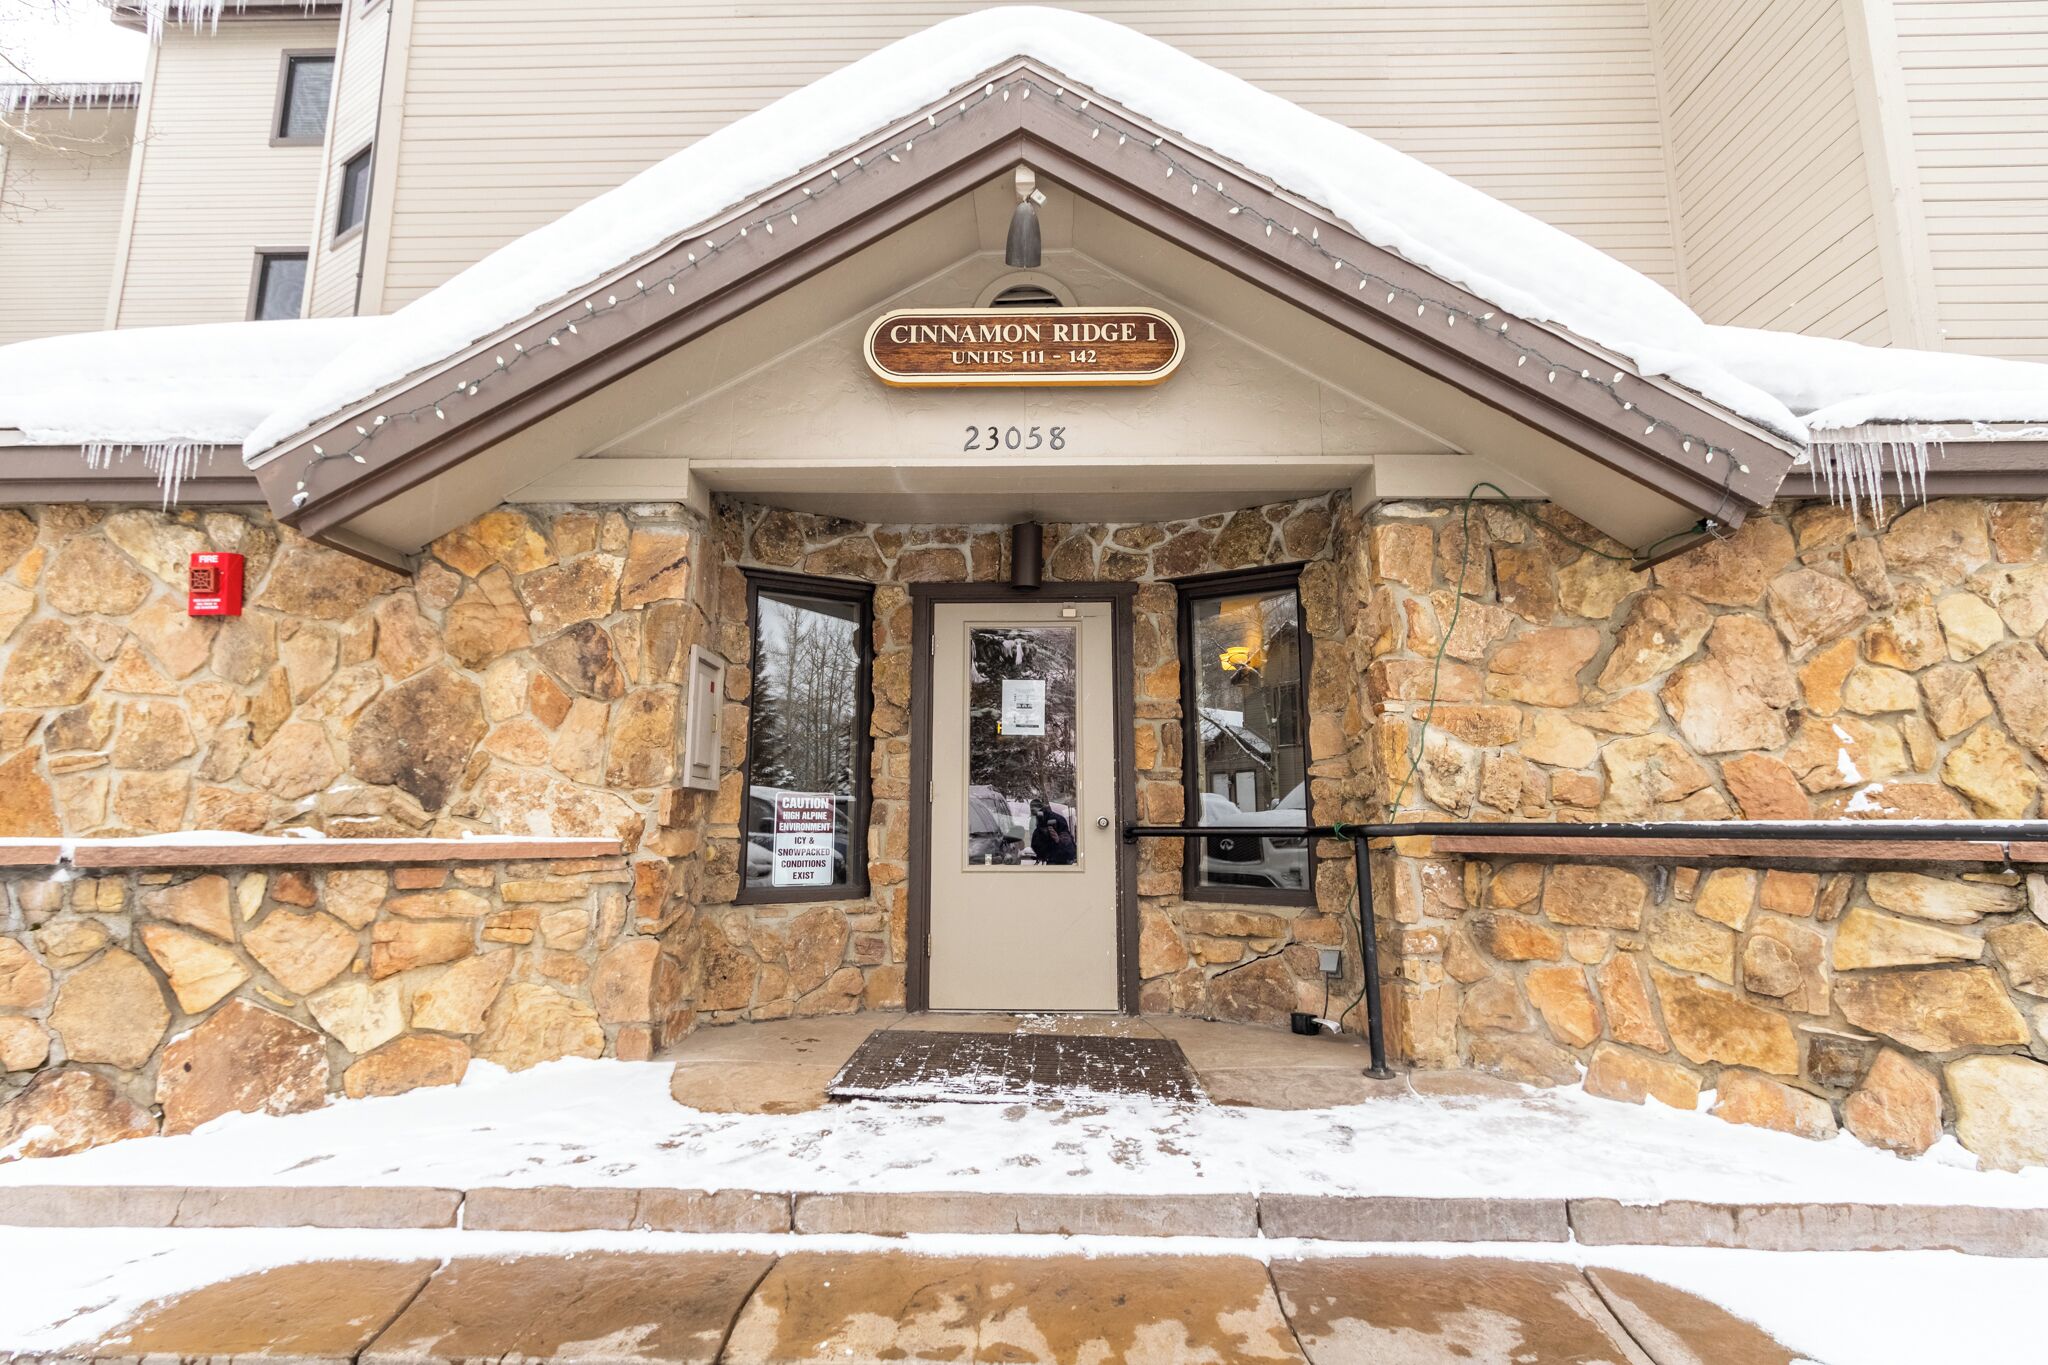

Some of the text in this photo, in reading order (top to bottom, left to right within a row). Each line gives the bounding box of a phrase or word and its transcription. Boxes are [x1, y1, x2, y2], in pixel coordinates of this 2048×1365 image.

[890, 322, 1158, 344] CINNAMON RIDGE I
[951, 350, 1014, 364] UNITS
[1022, 350, 1045, 364] 111
[1069, 350, 1097, 363] 142
[963, 426, 1067, 452] 23058
[199, 555, 218, 563] FIRE
[782, 797, 829, 809] CAUTION
[783, 811, 827, 820] HIGH ALPINE
[779, 822, 831, 832] ENVIRONMENT
[778, 848, 830, 856] SNOWPACKED
[781, 860, 826, 868] CONDITIONS
